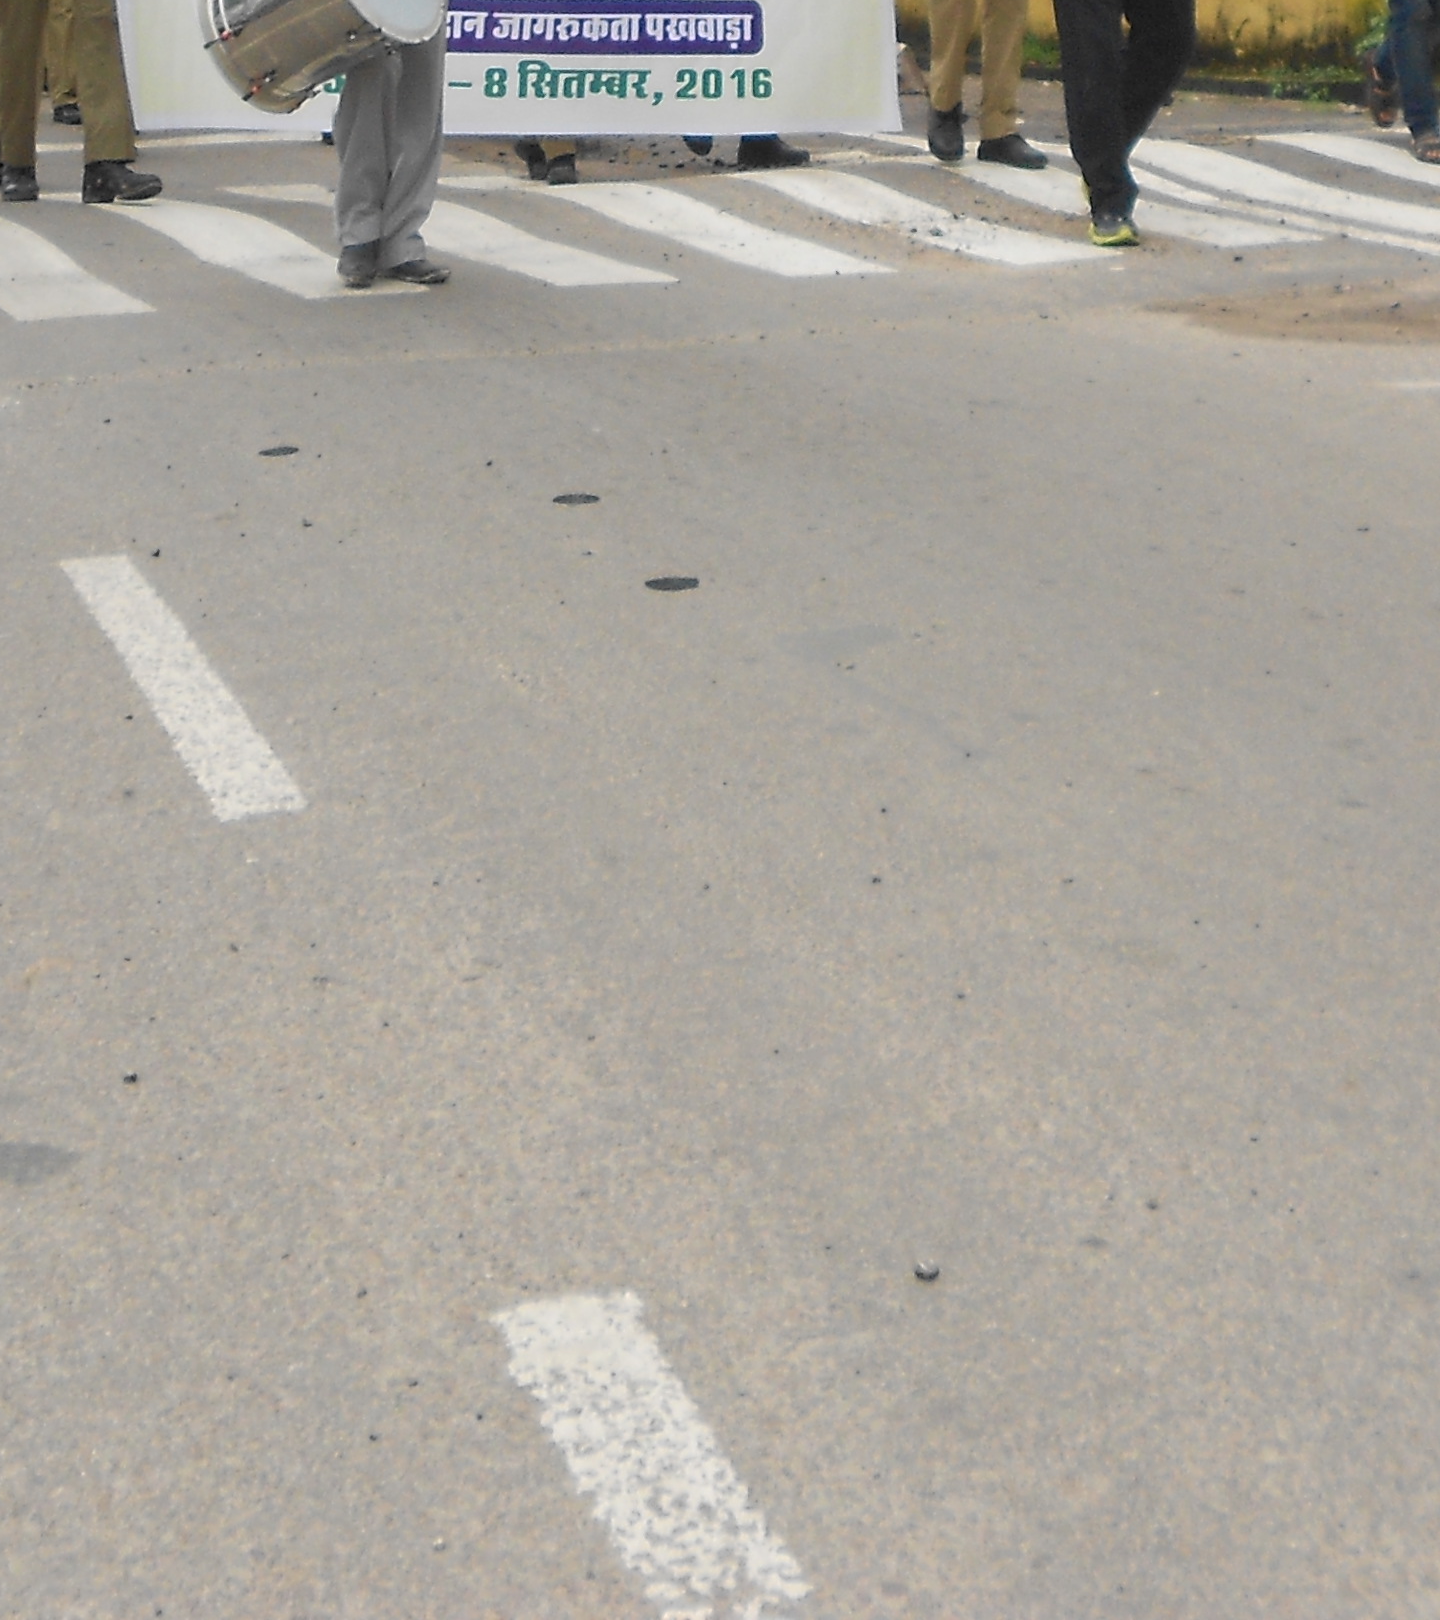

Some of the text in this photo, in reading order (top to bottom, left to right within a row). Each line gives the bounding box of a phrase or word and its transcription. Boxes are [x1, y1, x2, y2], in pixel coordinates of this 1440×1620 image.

[484, 67, 508, 99] 8
[518, 60, 663, 107] सितम्बर,
[675, 67, 773, 99] 2016
